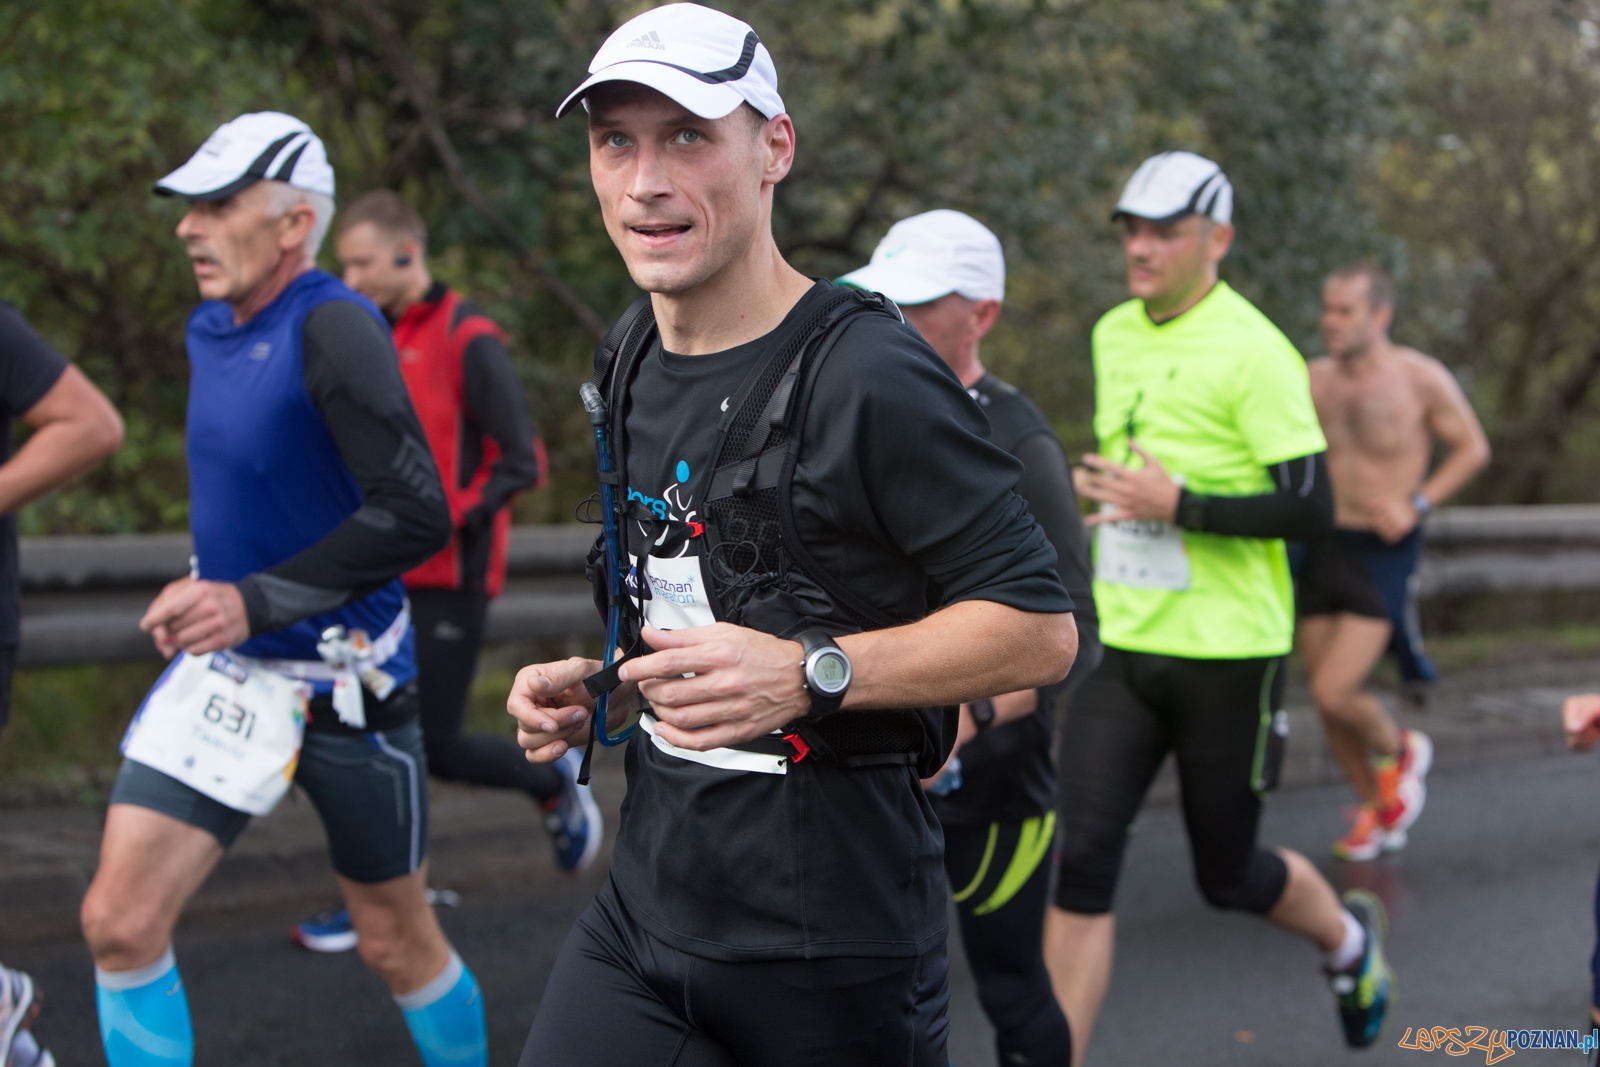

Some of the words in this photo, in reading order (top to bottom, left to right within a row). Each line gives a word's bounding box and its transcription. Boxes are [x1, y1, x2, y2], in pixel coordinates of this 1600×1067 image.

[626, 40, 666, 50] adidas
[654, 586, 696, 604] maraton
[203, 693, 257, 741] 631
